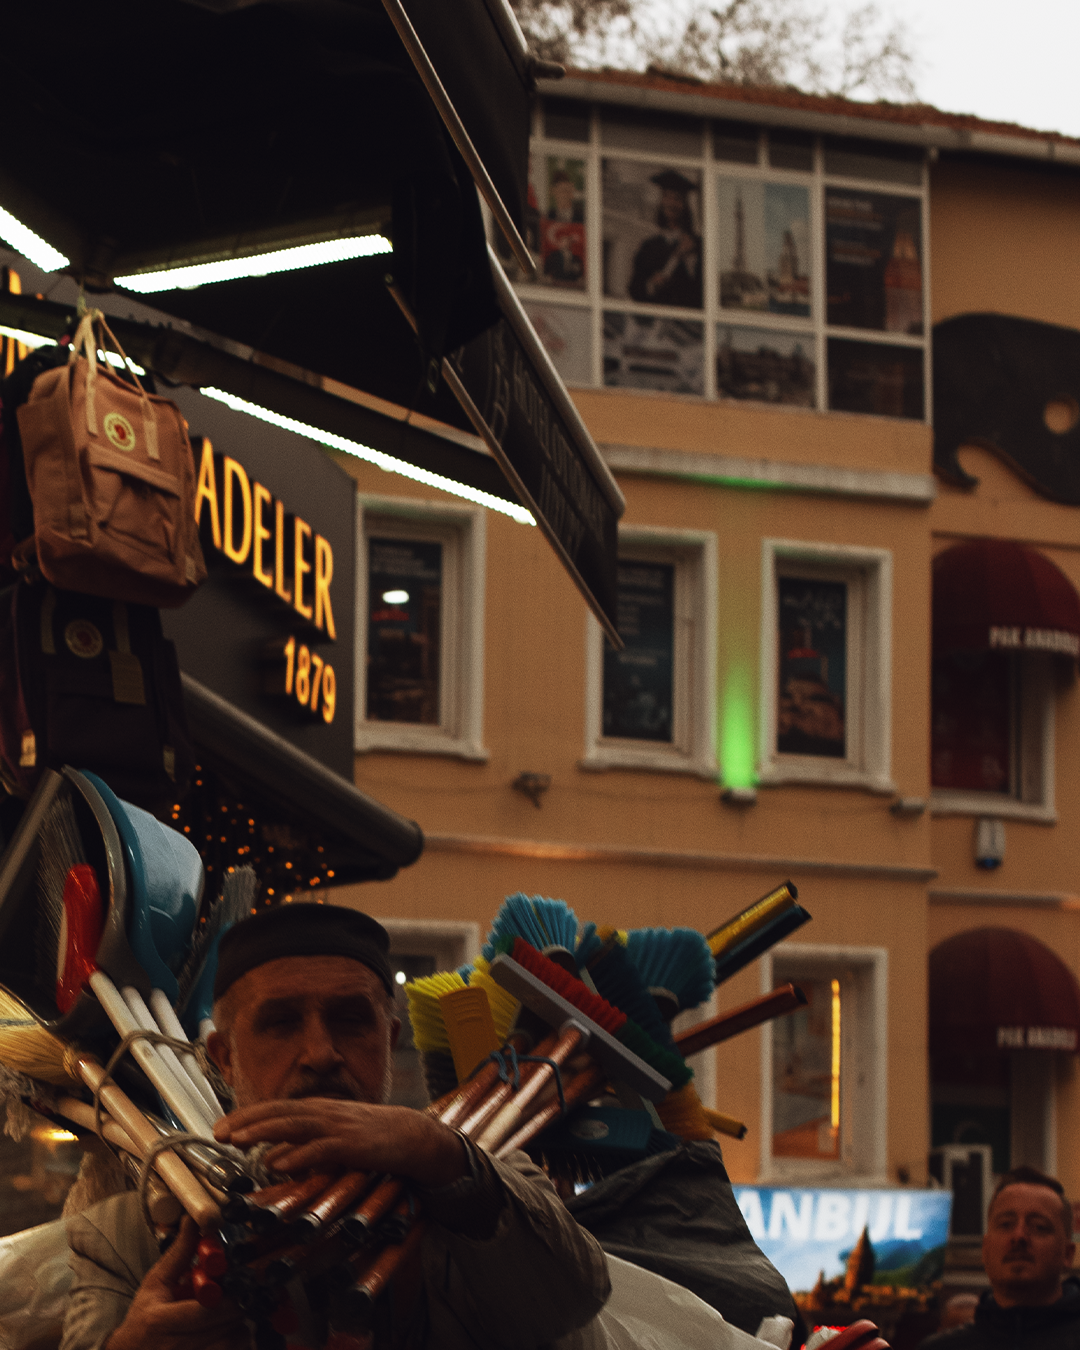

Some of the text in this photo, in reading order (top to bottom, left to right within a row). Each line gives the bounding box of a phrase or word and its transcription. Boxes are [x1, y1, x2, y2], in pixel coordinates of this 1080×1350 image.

[192, 436, 337, 641] ADELER
[284, 636, 337, 724] 1879
[736, 1190, 923, 1243] ANBUL
